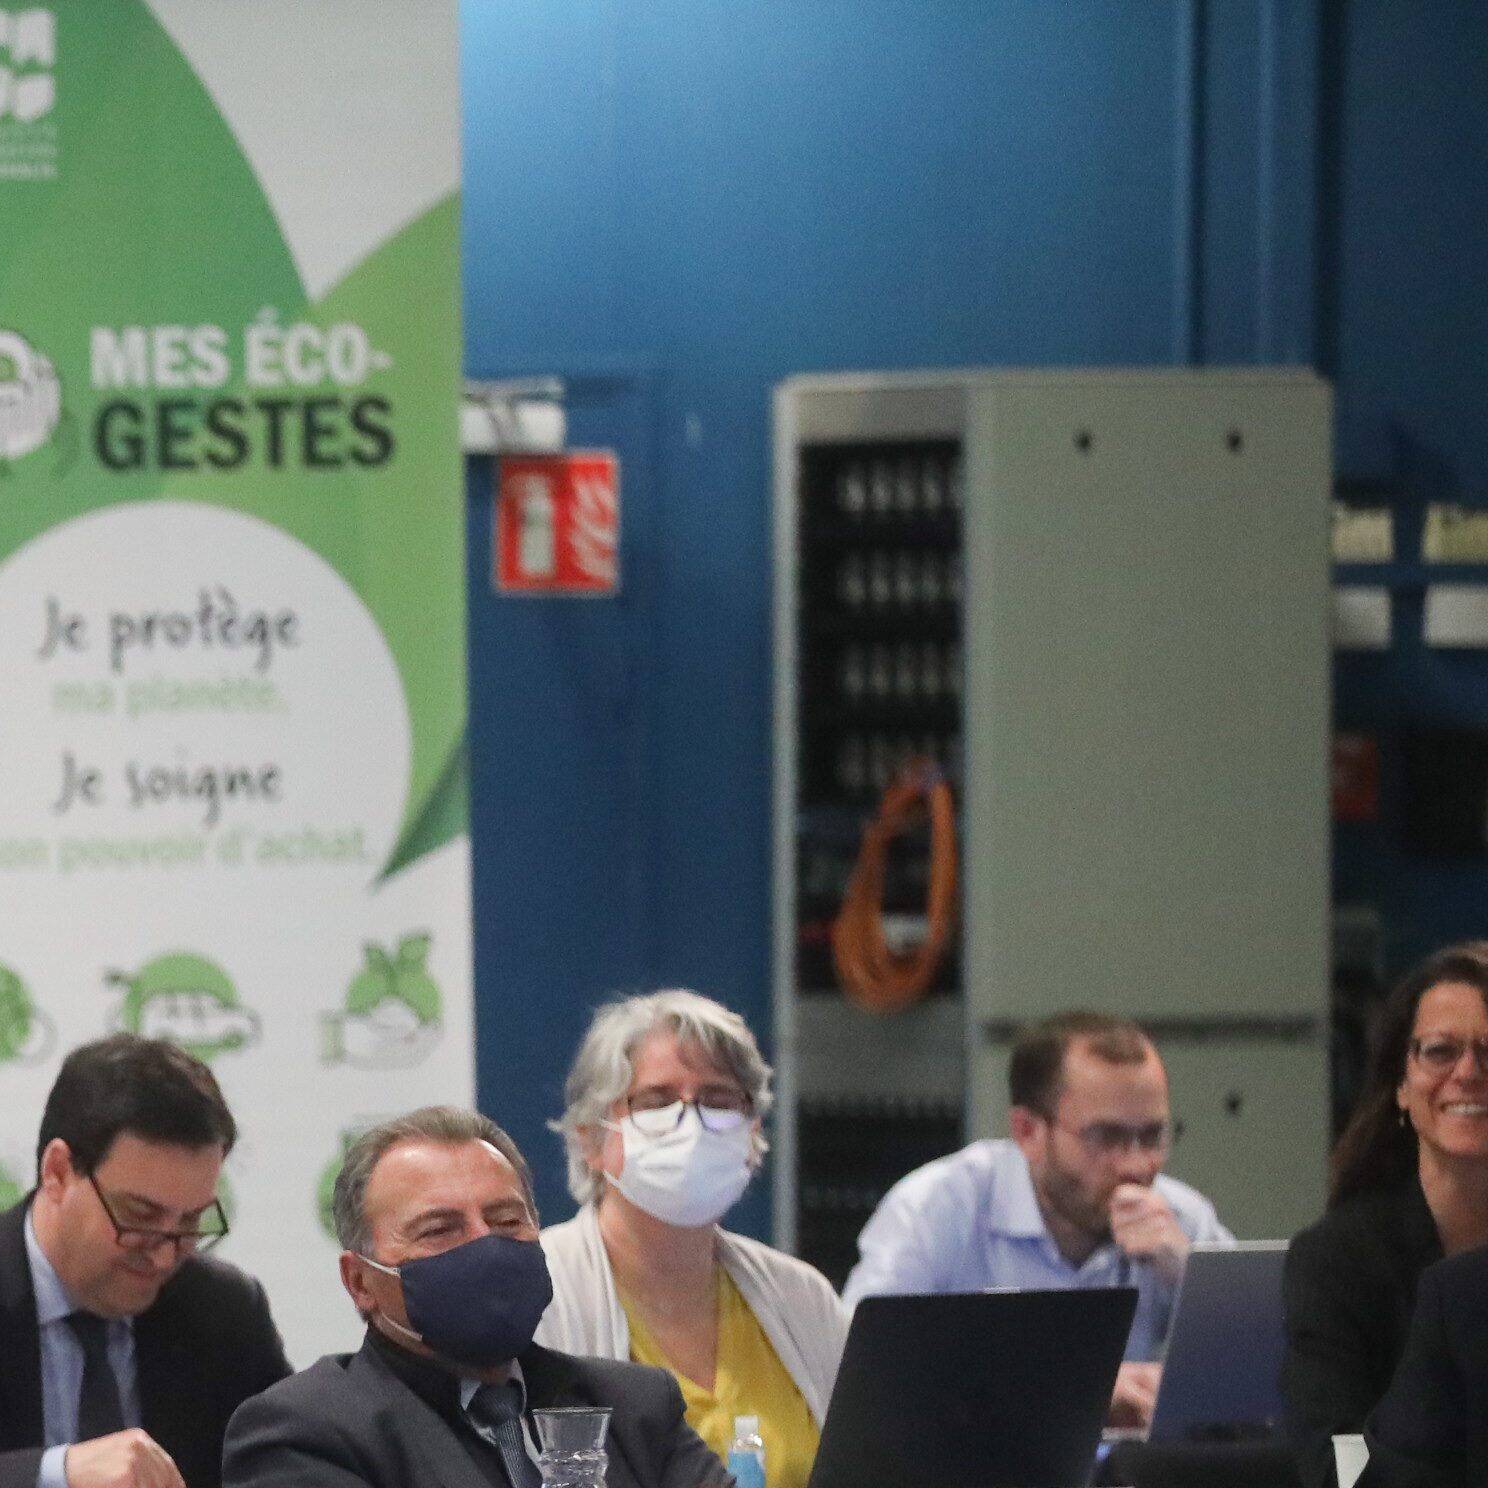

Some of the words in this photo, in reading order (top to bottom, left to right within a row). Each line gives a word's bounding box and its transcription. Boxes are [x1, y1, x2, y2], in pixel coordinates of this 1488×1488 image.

[89, 323, 230, 389] MES
[243, 306, 394, 388] ÉCO-
[92, 394, 396, 472] GESTES
[36, 595, 88, 661] Je
[109, 584, 302, 674] protège
[53, 750, 104, 815] Je
[125, 749, 282, 830] soigne
